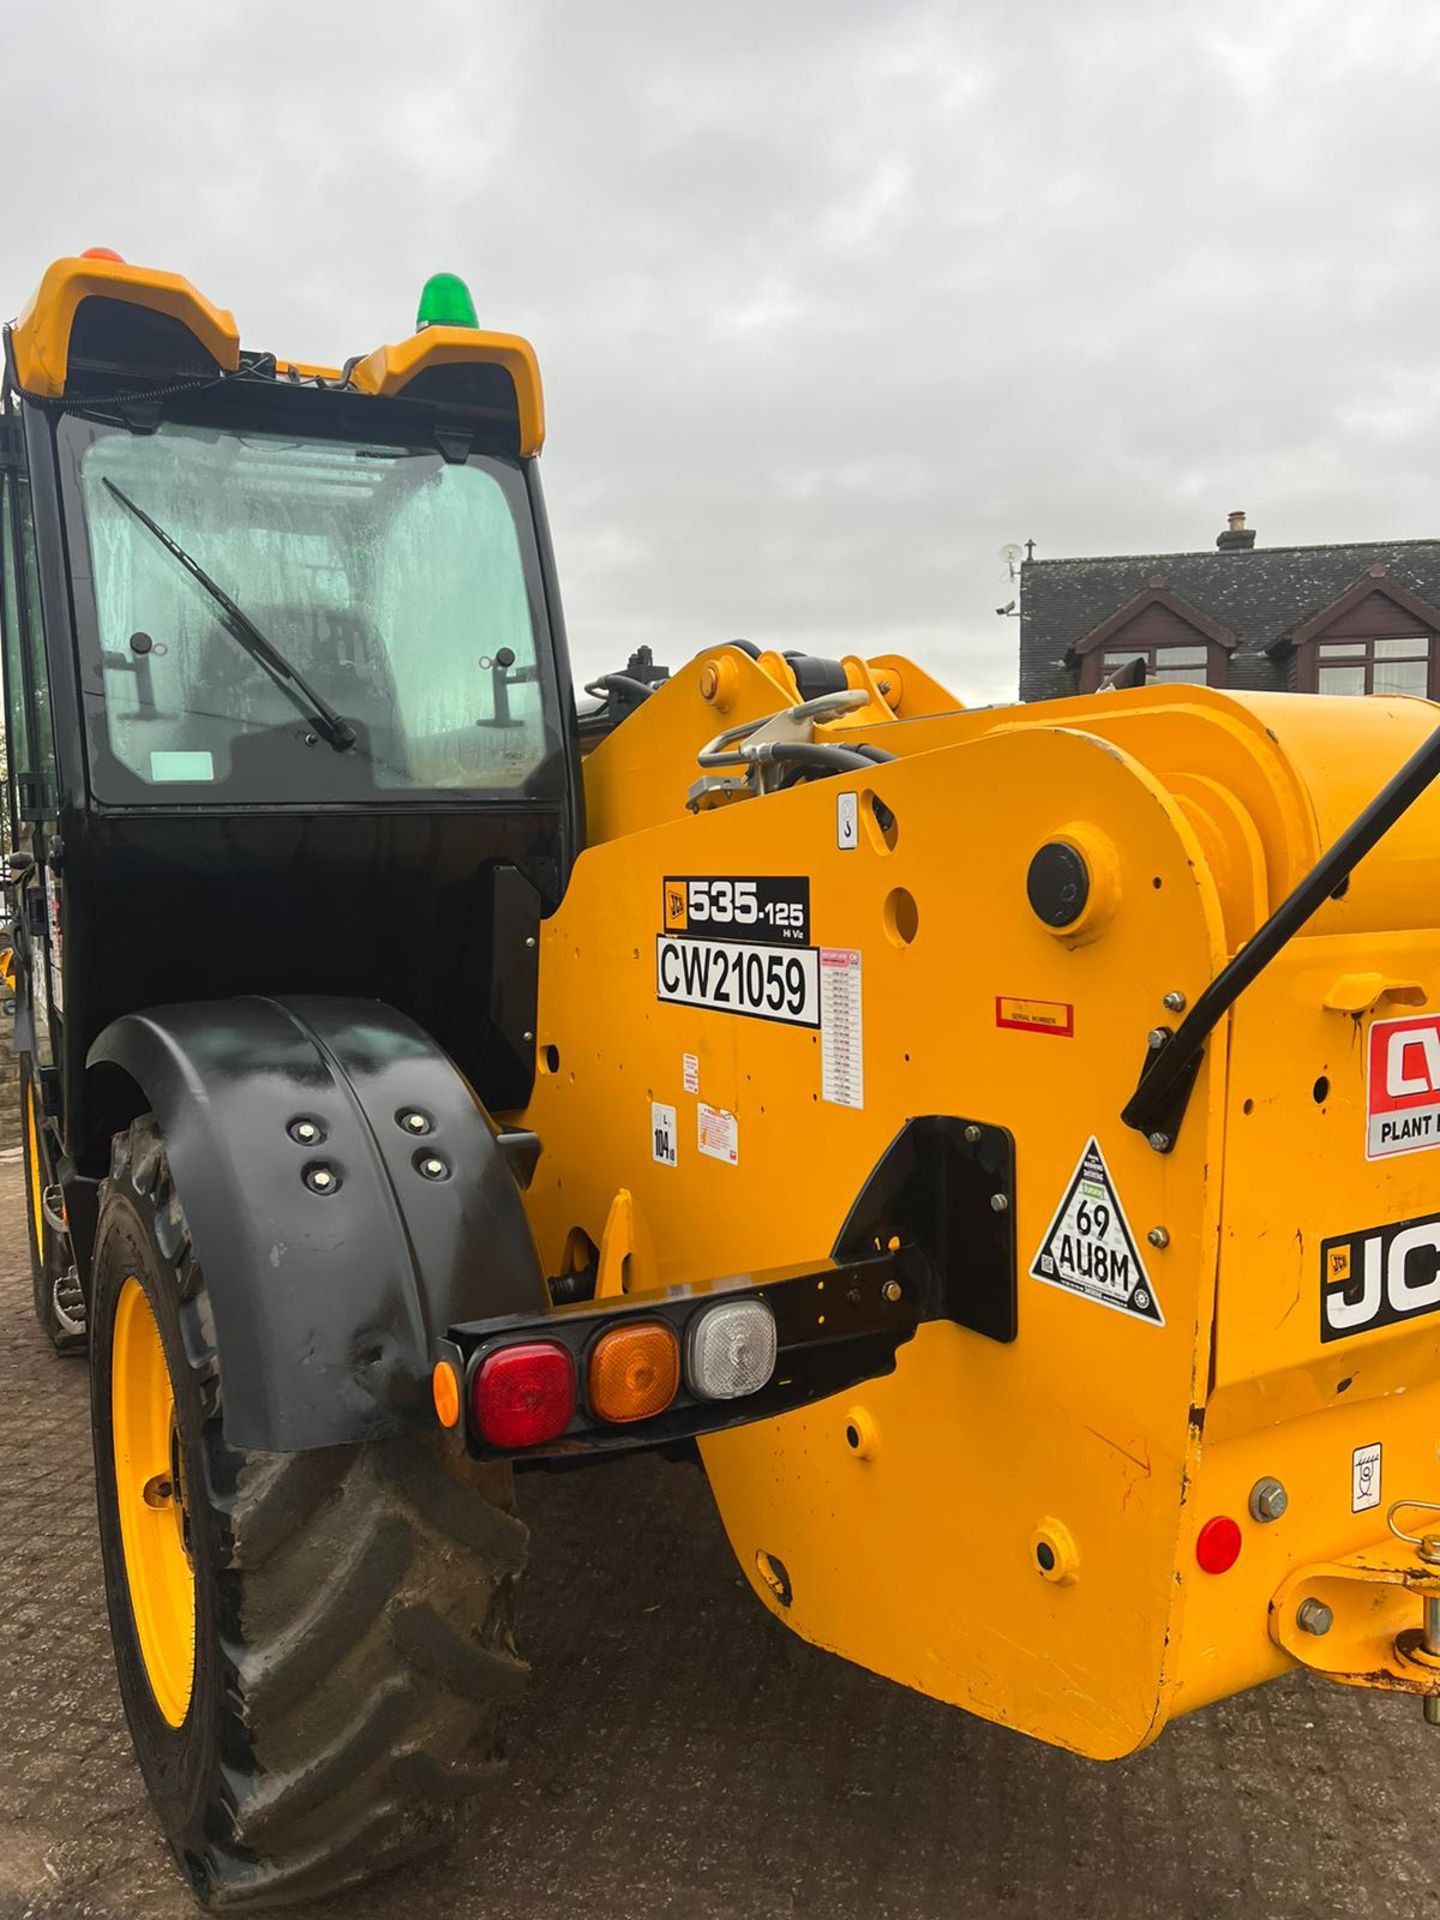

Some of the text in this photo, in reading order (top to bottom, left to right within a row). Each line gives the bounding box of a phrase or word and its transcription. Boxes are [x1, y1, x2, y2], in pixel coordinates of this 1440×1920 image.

[660, 943, 806, 1015] CW21059
[1011, 1012, 1056, 1024] SERIAL NUMBER
[654, 1128, 669, 1159] 104
[1381, 1115, 1432, 1143] PLANT
[1076, 1200, 1110, 1241] 69
[1060, 1234, 1129, 1292] AU8M
